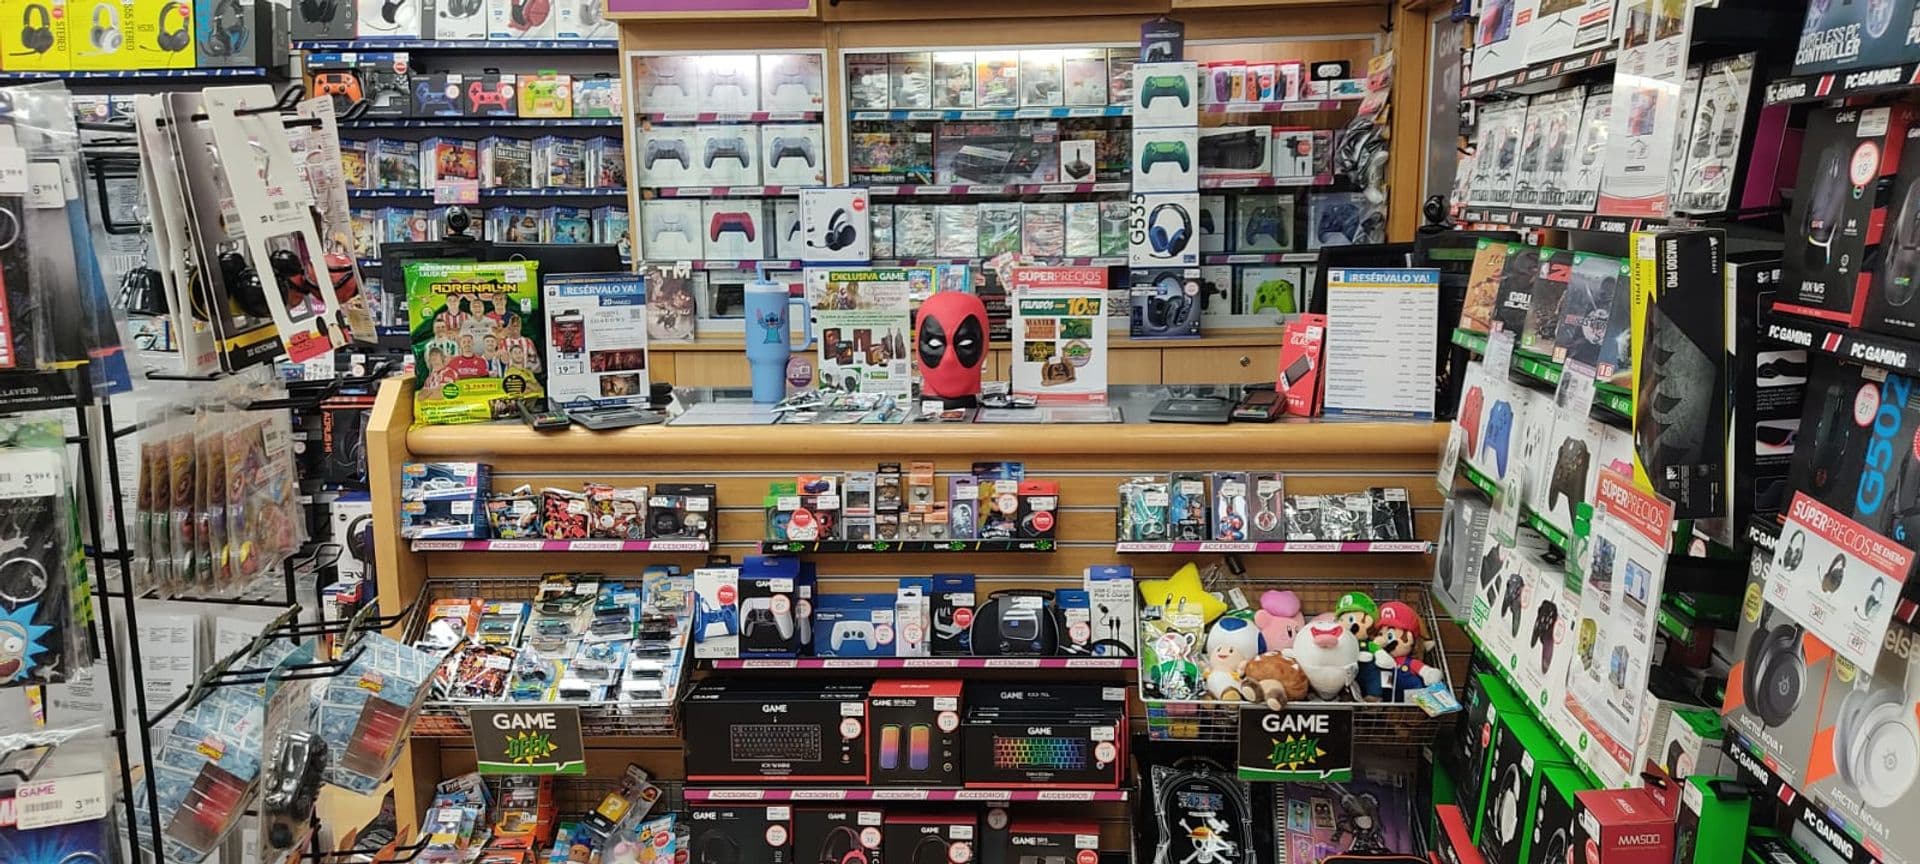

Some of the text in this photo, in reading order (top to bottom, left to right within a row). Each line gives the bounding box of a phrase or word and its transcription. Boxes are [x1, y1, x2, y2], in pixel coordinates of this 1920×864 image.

[1795, 39, 1861, 65] CONTROLLER
[1844, 67, 1902, 90] PC GAMING
[1130, 194, 1146, 246] G535
[431, 282, 519, 294] ADRENALYN
[831, 273, 906, 281] EXCLUSIVA GAME
[1349, 272, 1431, 283] ¡RESÉRVALO YA!
[564, 283, 637, 296] ¡RESÉRVALO YA!
[1769, 325, 1812, 347] PC GAMING
[1851, 342, 1907, 368] PC GAMING
[1600, 477, 1666, 529] SÚPERPRECIOS
[1749, 526, 1760, 542] PC
[1793, 499, 1873, 557] SÚPERPRECIOS
[762, 704, 788, 713] GAME
[492, 712, 557, 730] GAME
[1028, 727, 1052, 736] GAME
[1261, 714, 1330, 733] GAME
[508, 732, 551, 759] GEEK
[1271, 738, 1319, 764] GEEK
[1730, 743, 1769, 785] PC GAMING
[19, 784, 56, 798] GAME
[693, 812, 717, 820] GAME
[1831, 787, 1861, 817] ARCTIS
[1859, 808, 1884, 835] NOVA
[1804, 808, 1854, 859] PC GAMING
